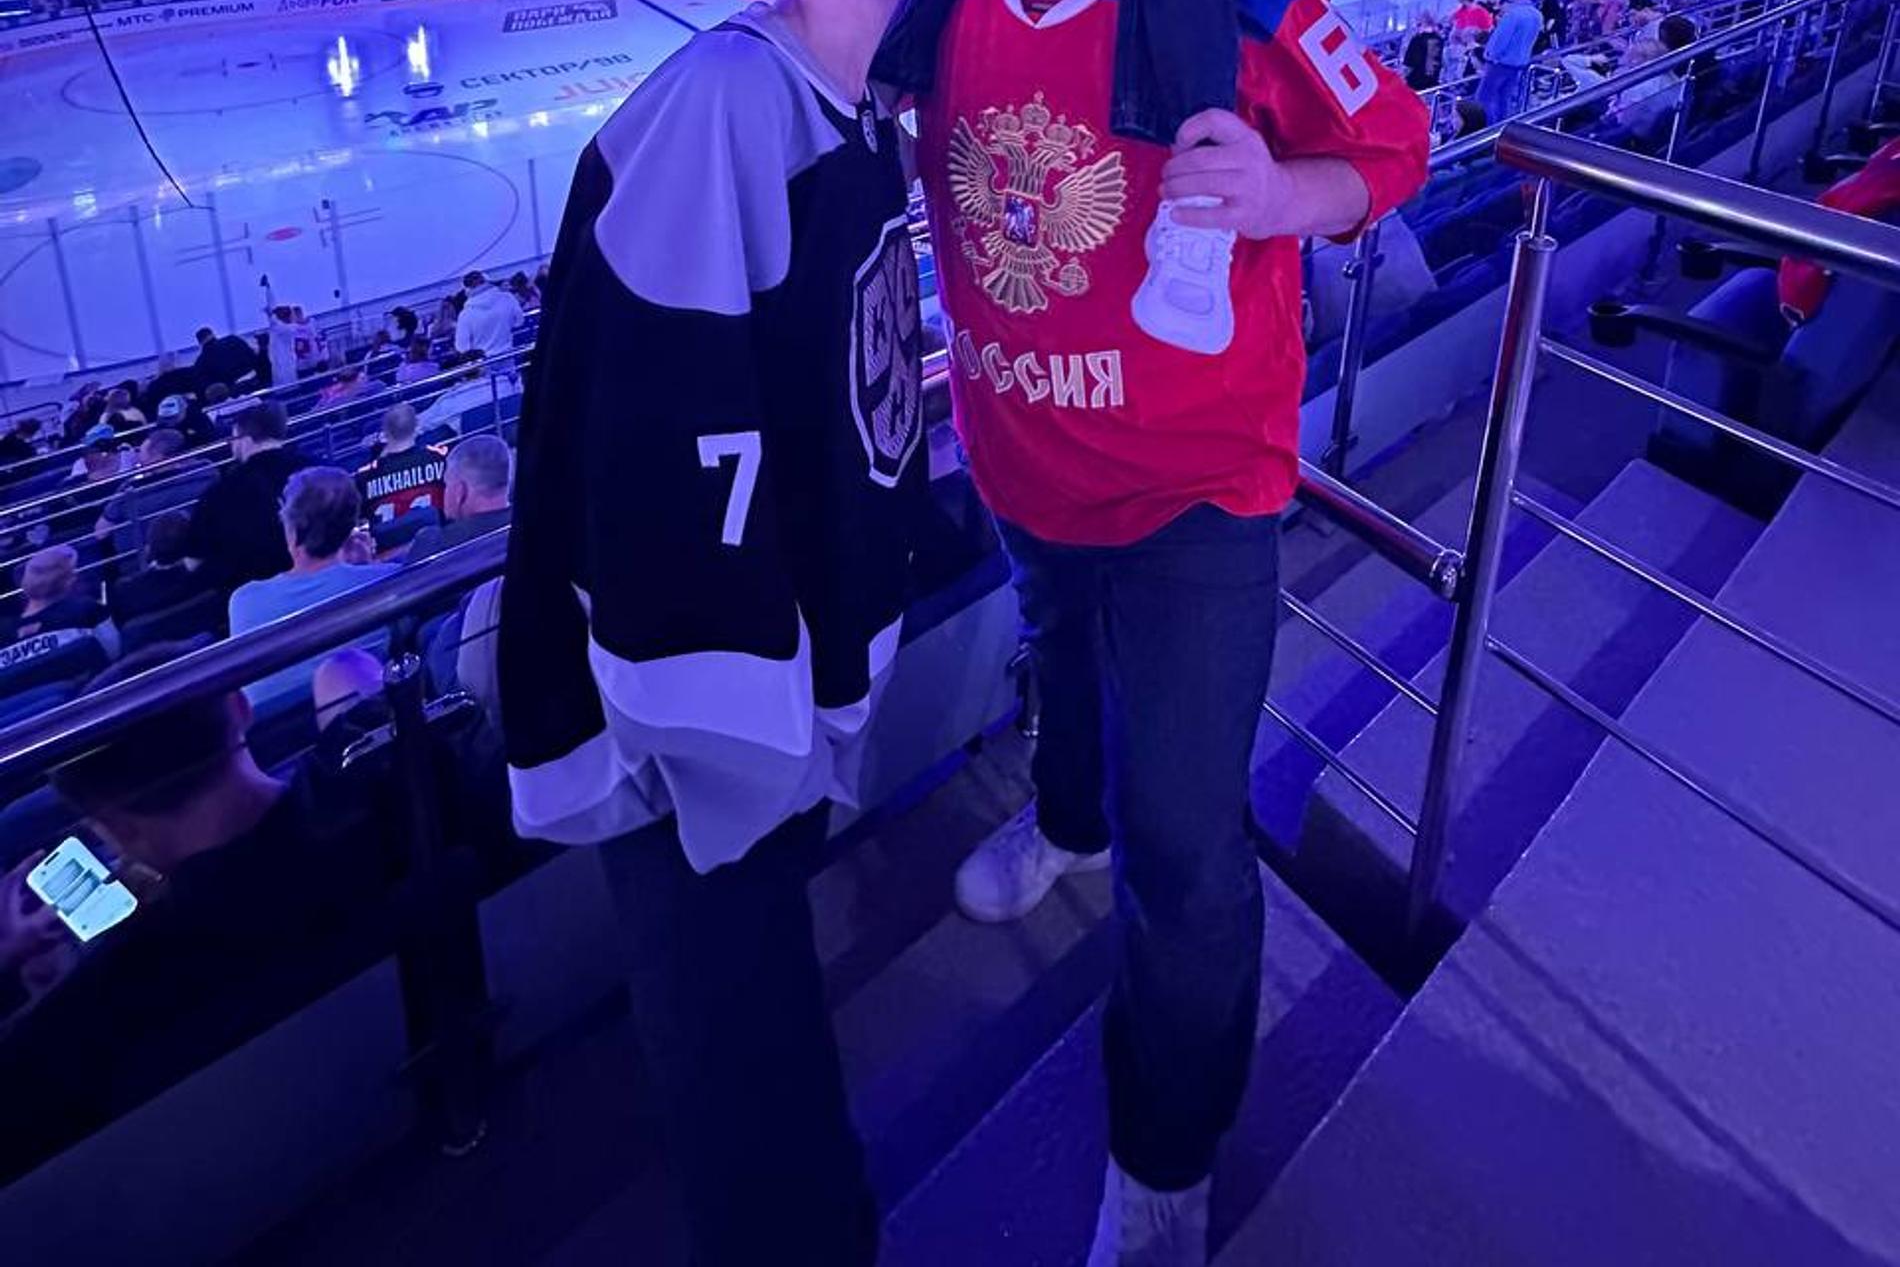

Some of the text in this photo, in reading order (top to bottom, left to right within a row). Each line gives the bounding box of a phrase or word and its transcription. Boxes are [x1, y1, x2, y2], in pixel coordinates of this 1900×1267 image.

[178, 2, 254, 18] PREMIUM
[950, 328, 1124, 409] ОССИЯ
[366, 461, 445, 499] MIKHAILOV
[697, 430, 762, 546] 7
